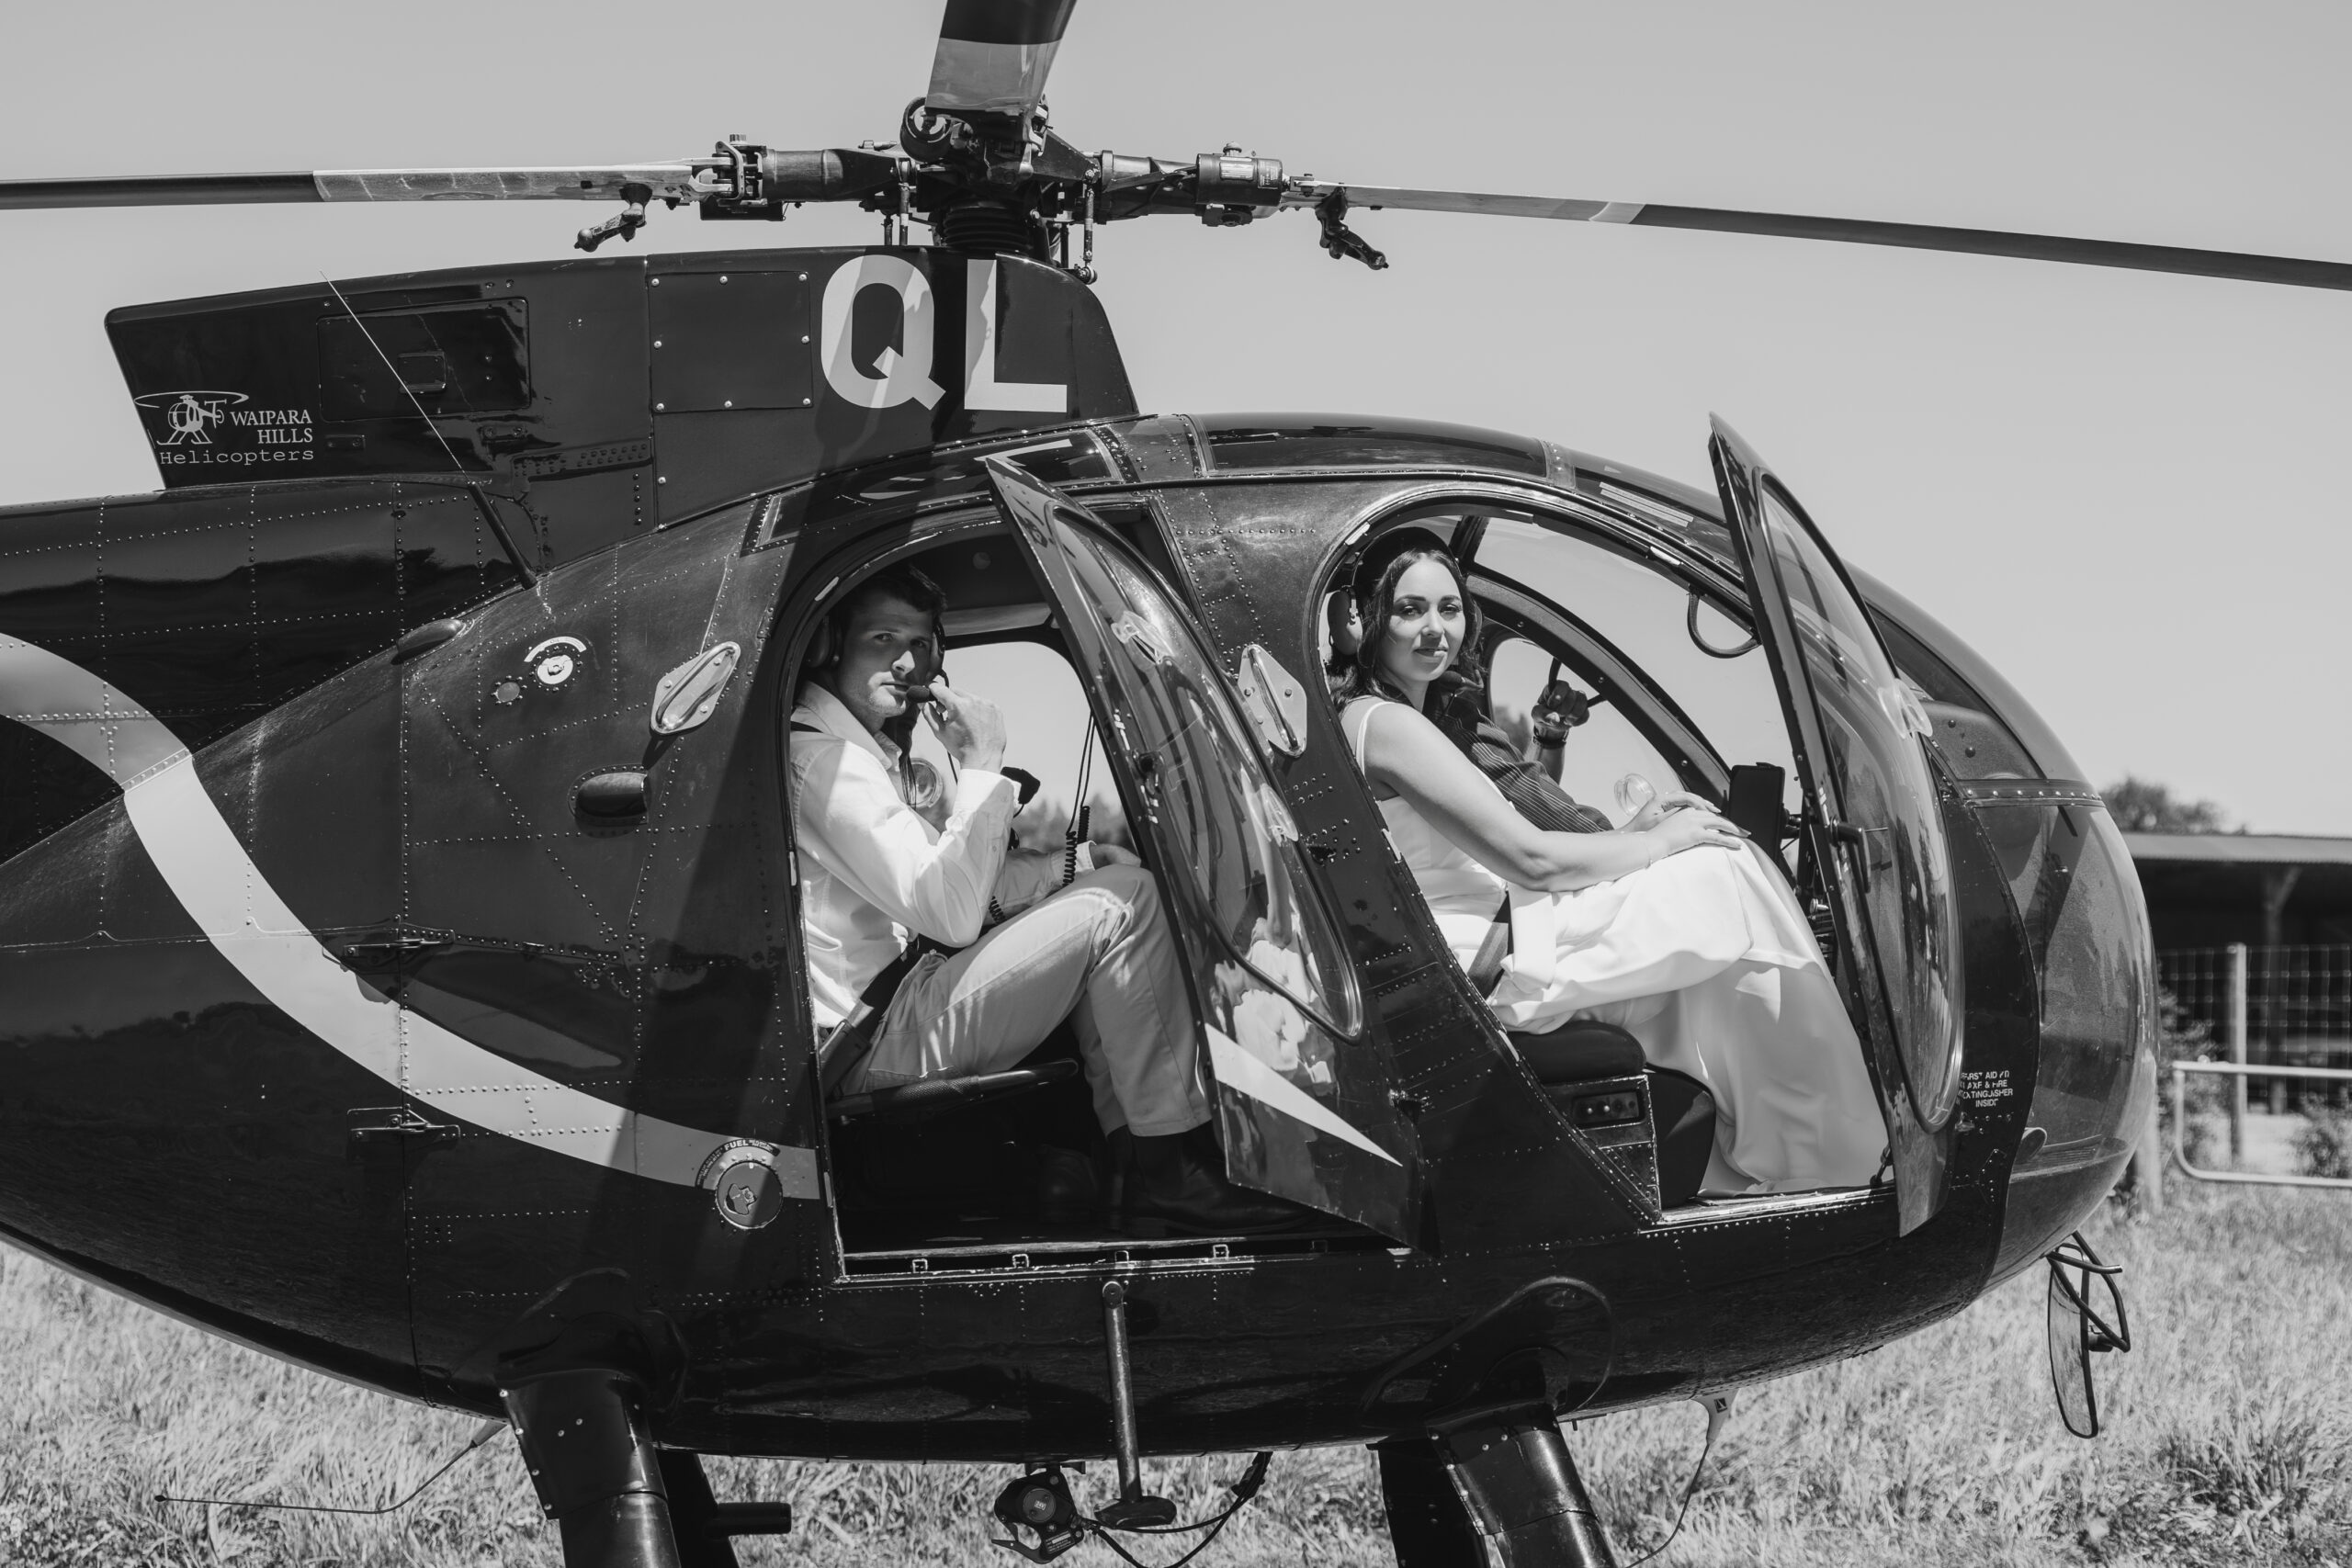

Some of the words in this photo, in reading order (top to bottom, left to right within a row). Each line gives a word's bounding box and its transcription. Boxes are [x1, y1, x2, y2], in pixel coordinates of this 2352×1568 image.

[820, 254, 1068, 412] QL
[231, 410, 313, 426] WAIPARA
[257, 427, 313, 444] HILLS
[160, 449, 314, 466] Helicopters
[1985, 1071, 1997, 1079] AID
[724, 1139, 749, 1151] FUEL
